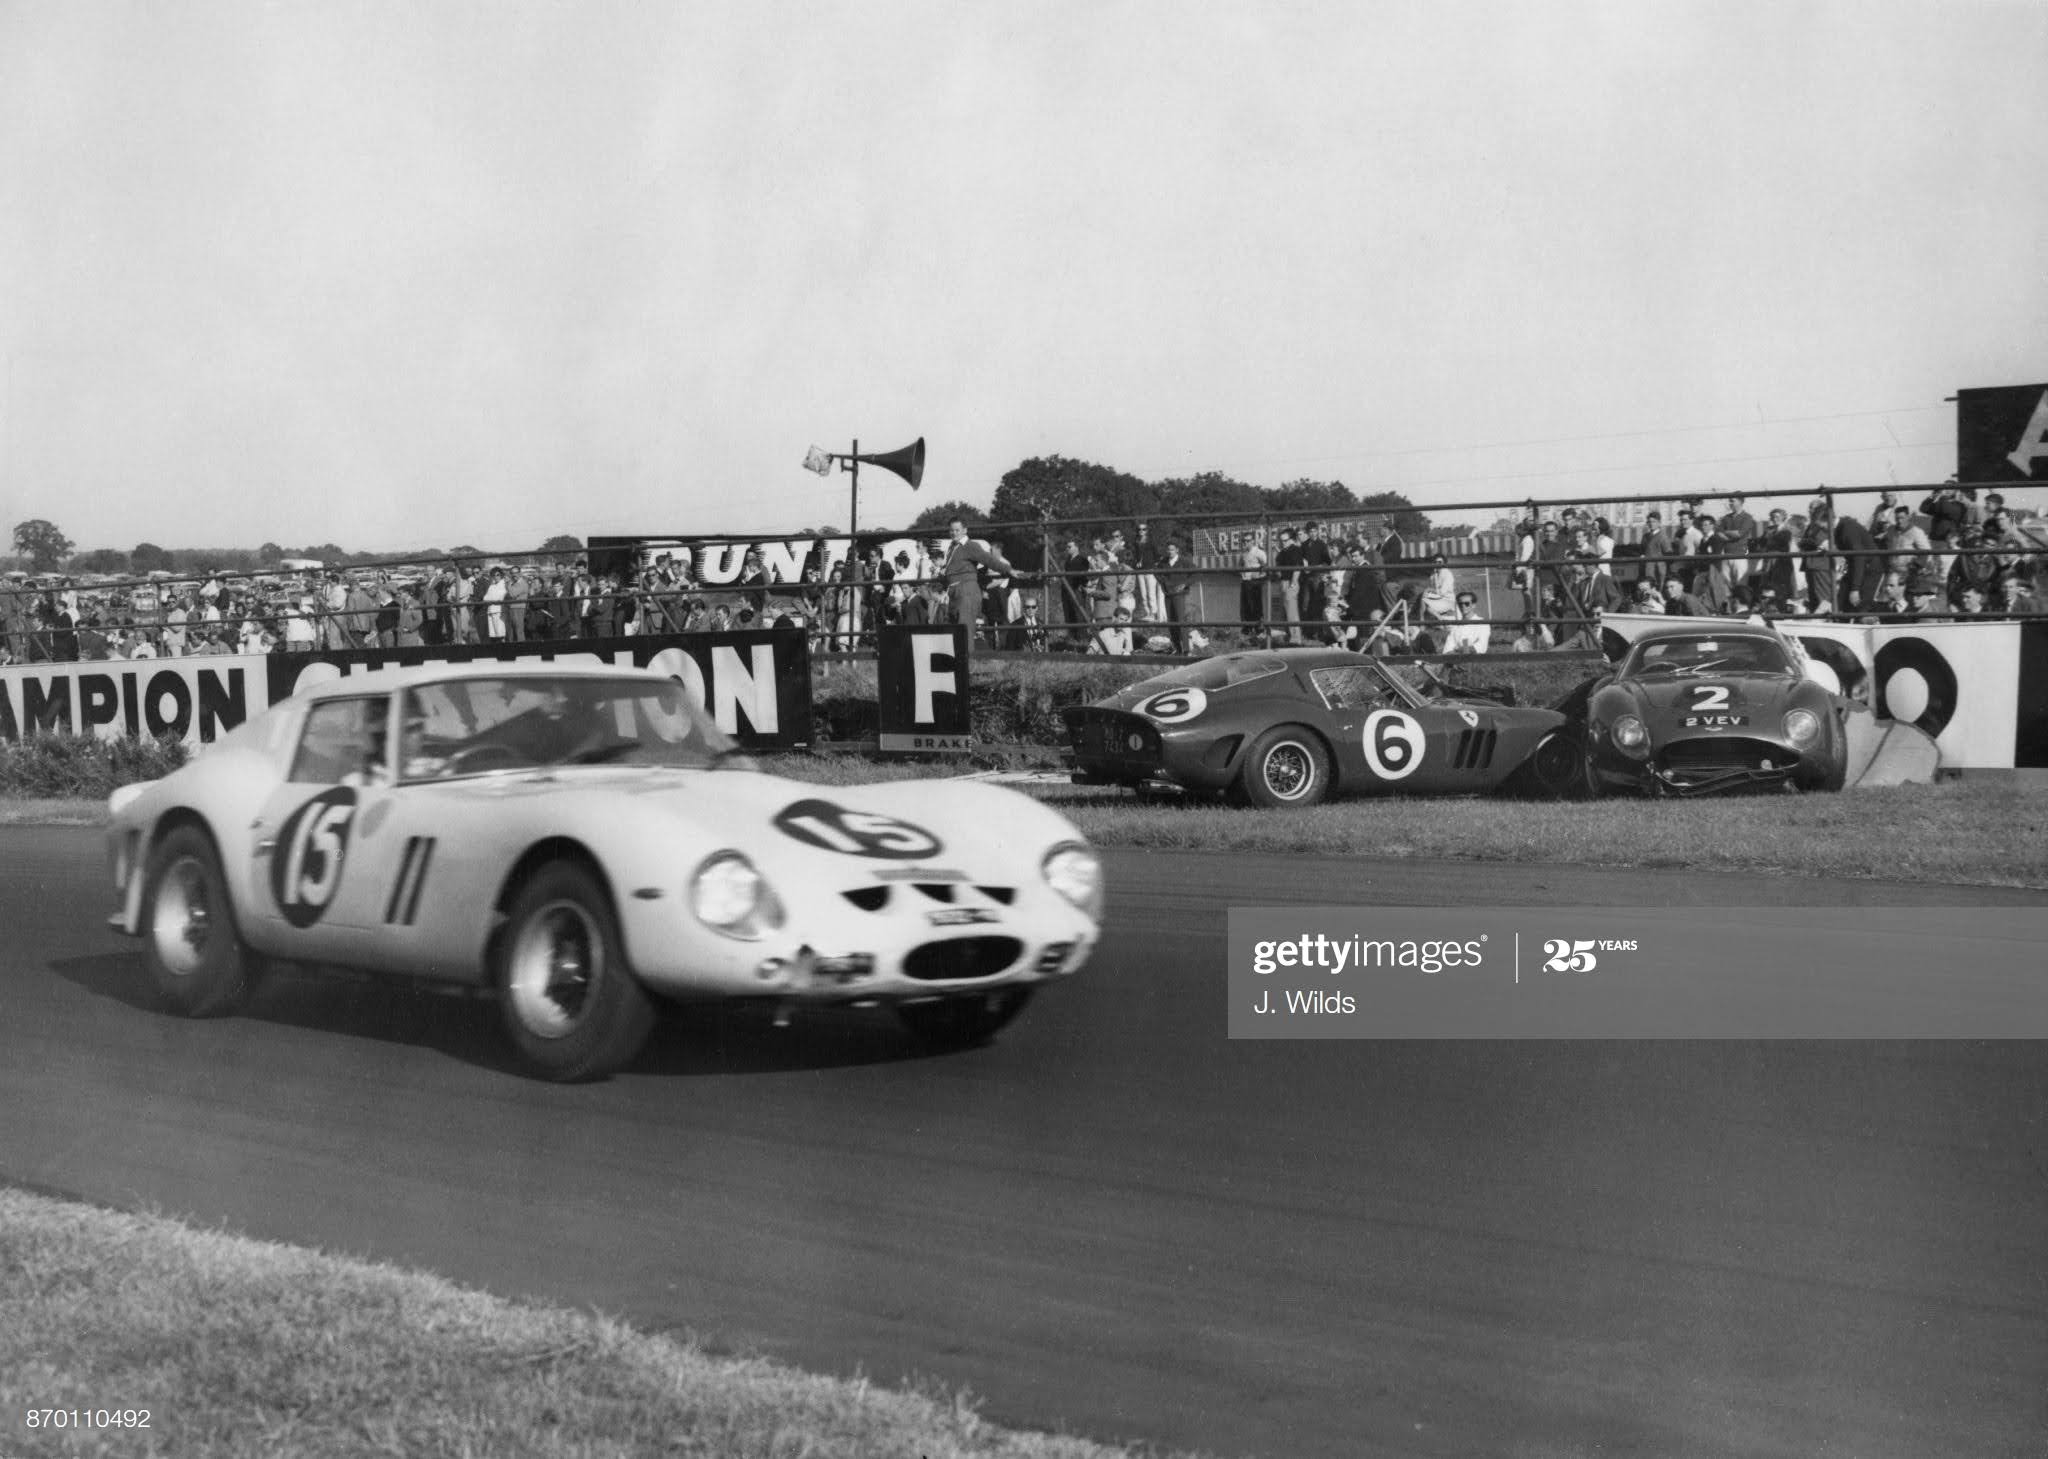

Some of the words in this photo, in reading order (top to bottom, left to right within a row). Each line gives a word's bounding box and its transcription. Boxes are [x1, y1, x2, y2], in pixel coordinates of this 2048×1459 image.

[638, 539, 992, 587] DUNO
[292, 644, 779, 744] AMION
[911, 633, 957, 724] F
[1691, 685, 1730, 711] 2
[1144, 688, 1191, 718] 6
[1685, 717, 1699, 727] 2
[1703, 715, 1741, 725] VEV
[1374, 715, 1413, 772] 6
[284, 802, 357, 906] 15
[786, 812, 936, 852] 15
